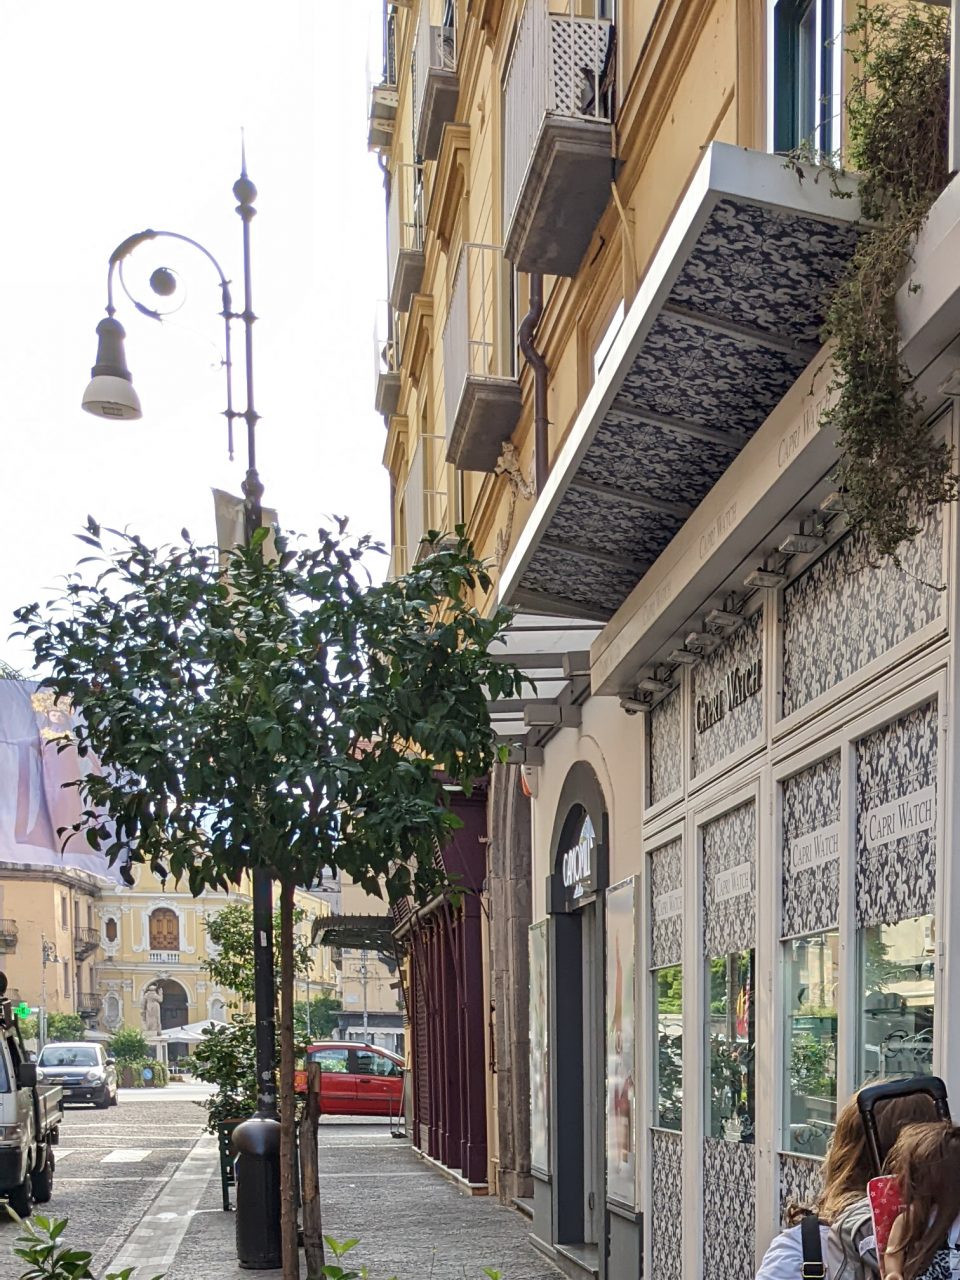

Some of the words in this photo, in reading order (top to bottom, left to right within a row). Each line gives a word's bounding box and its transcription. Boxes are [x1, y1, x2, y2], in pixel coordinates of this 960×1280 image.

[778, 425, 801, 468] CAPRI
[695, 689, 724, 734] CAPRI
[725, 658, 763, 712] WATCH
[869, 812, 896, 842] CAPRI
[898, 798, 932, 830] WATCH
[792, 843, 812, 868] CAPRI
[813, 832, 839, 859] WATCH
[716, 877, 730, 898] CAPRI
[730, 871, 749, 892] WATCH
